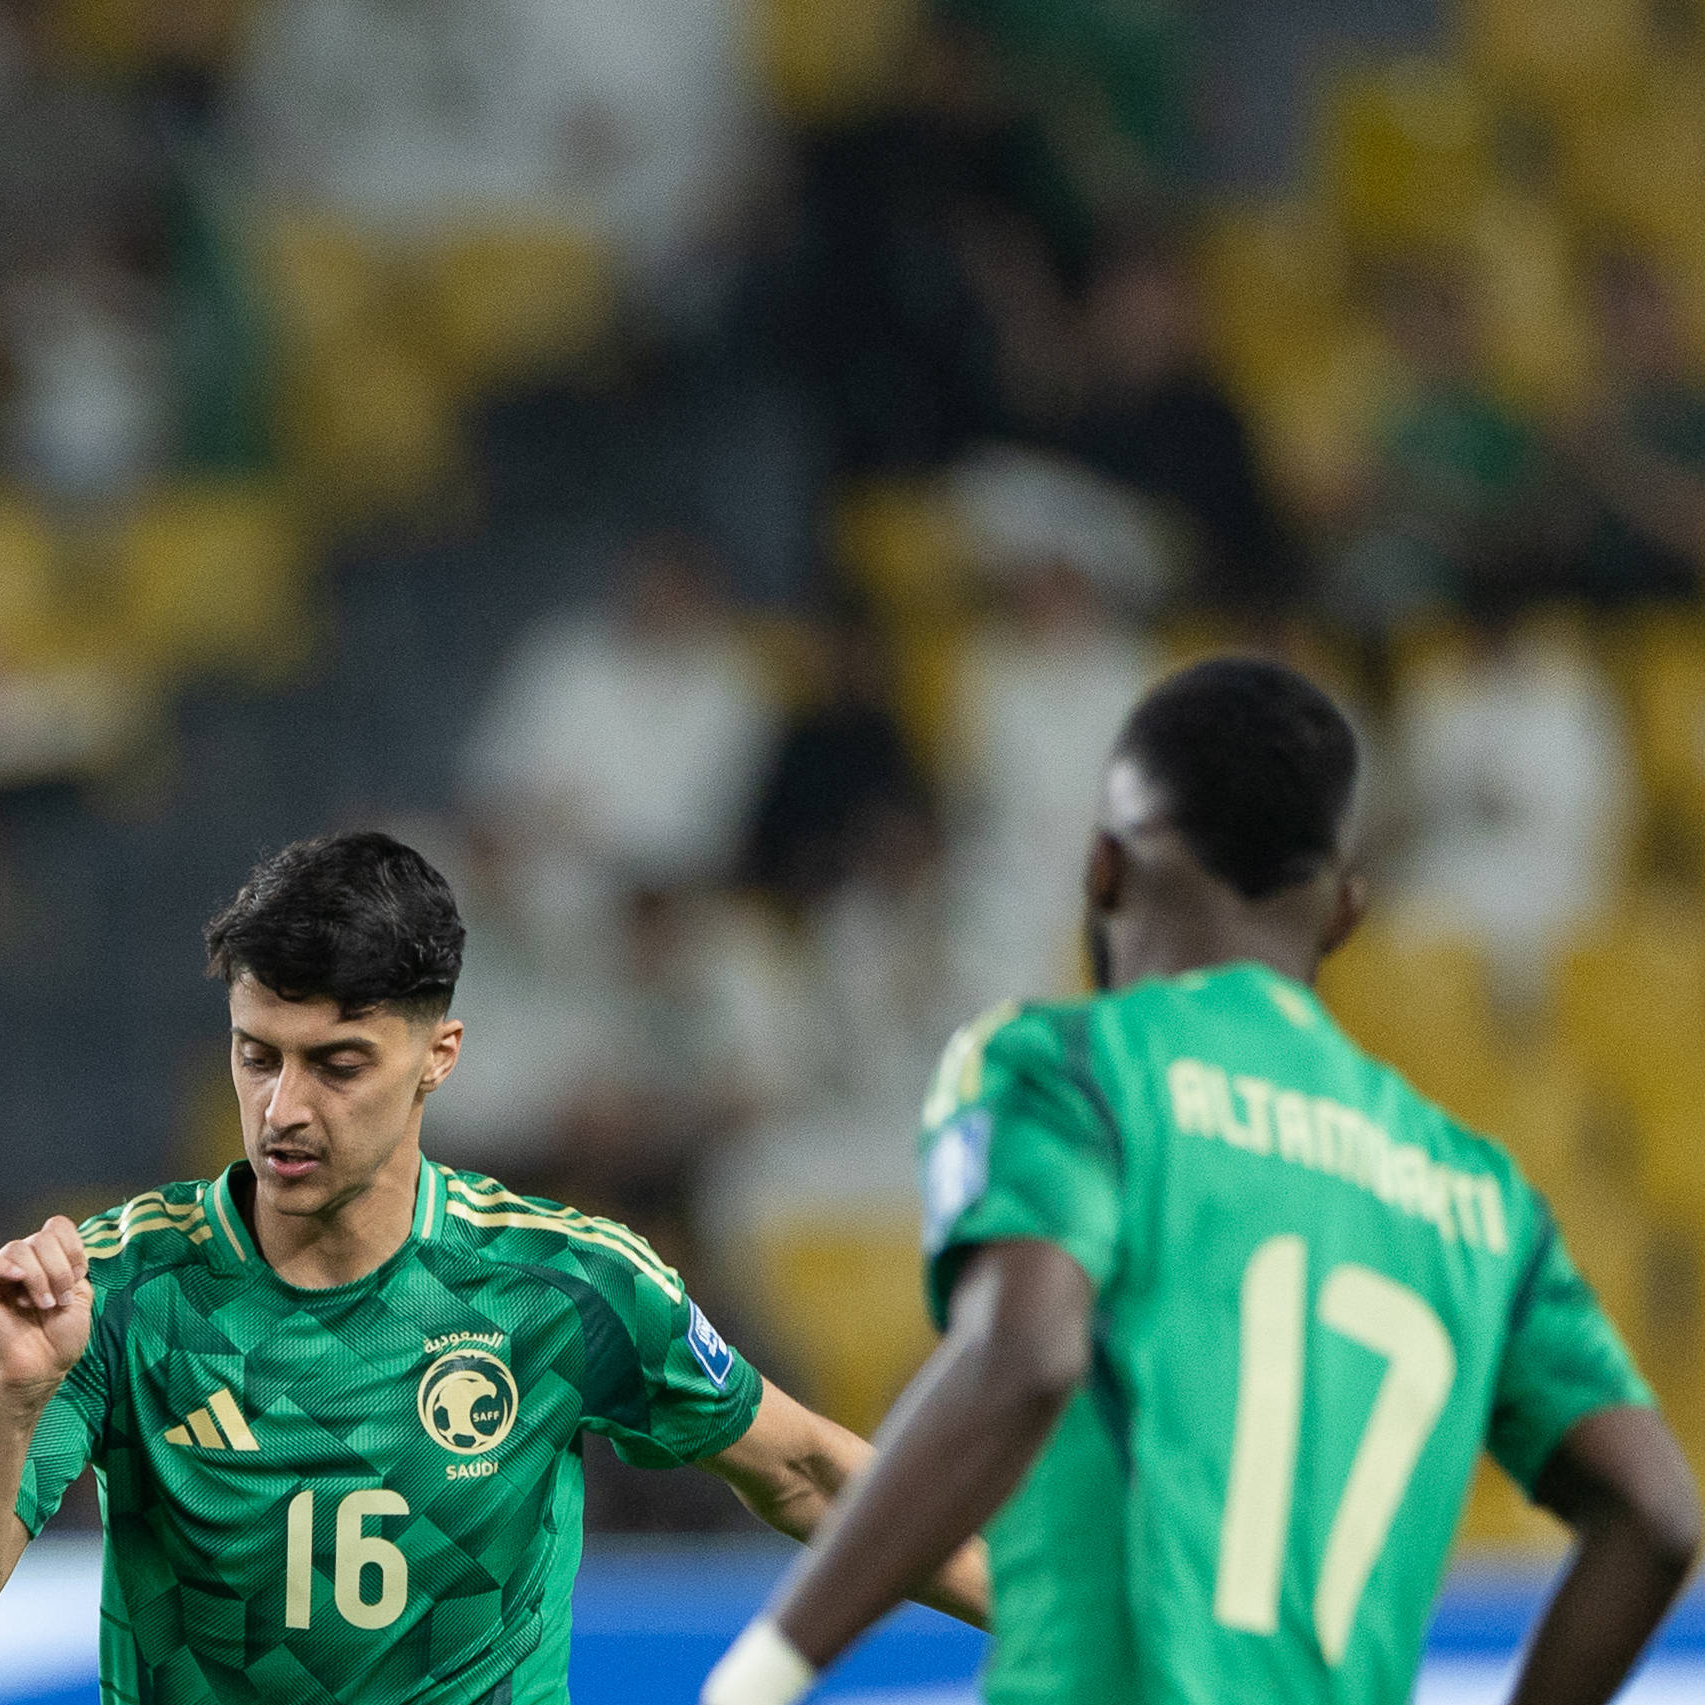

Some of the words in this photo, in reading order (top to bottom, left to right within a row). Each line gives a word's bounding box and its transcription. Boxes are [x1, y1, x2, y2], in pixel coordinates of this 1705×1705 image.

[424, 1331, 504, 1353] السعودية
[472, 1411, 500, 1423] SAFF
[1213, 1233, 1458, 1666] 17
[446, 1461, 499, 1481] SAUDI
[285, 1488, 410, 1630] 16
